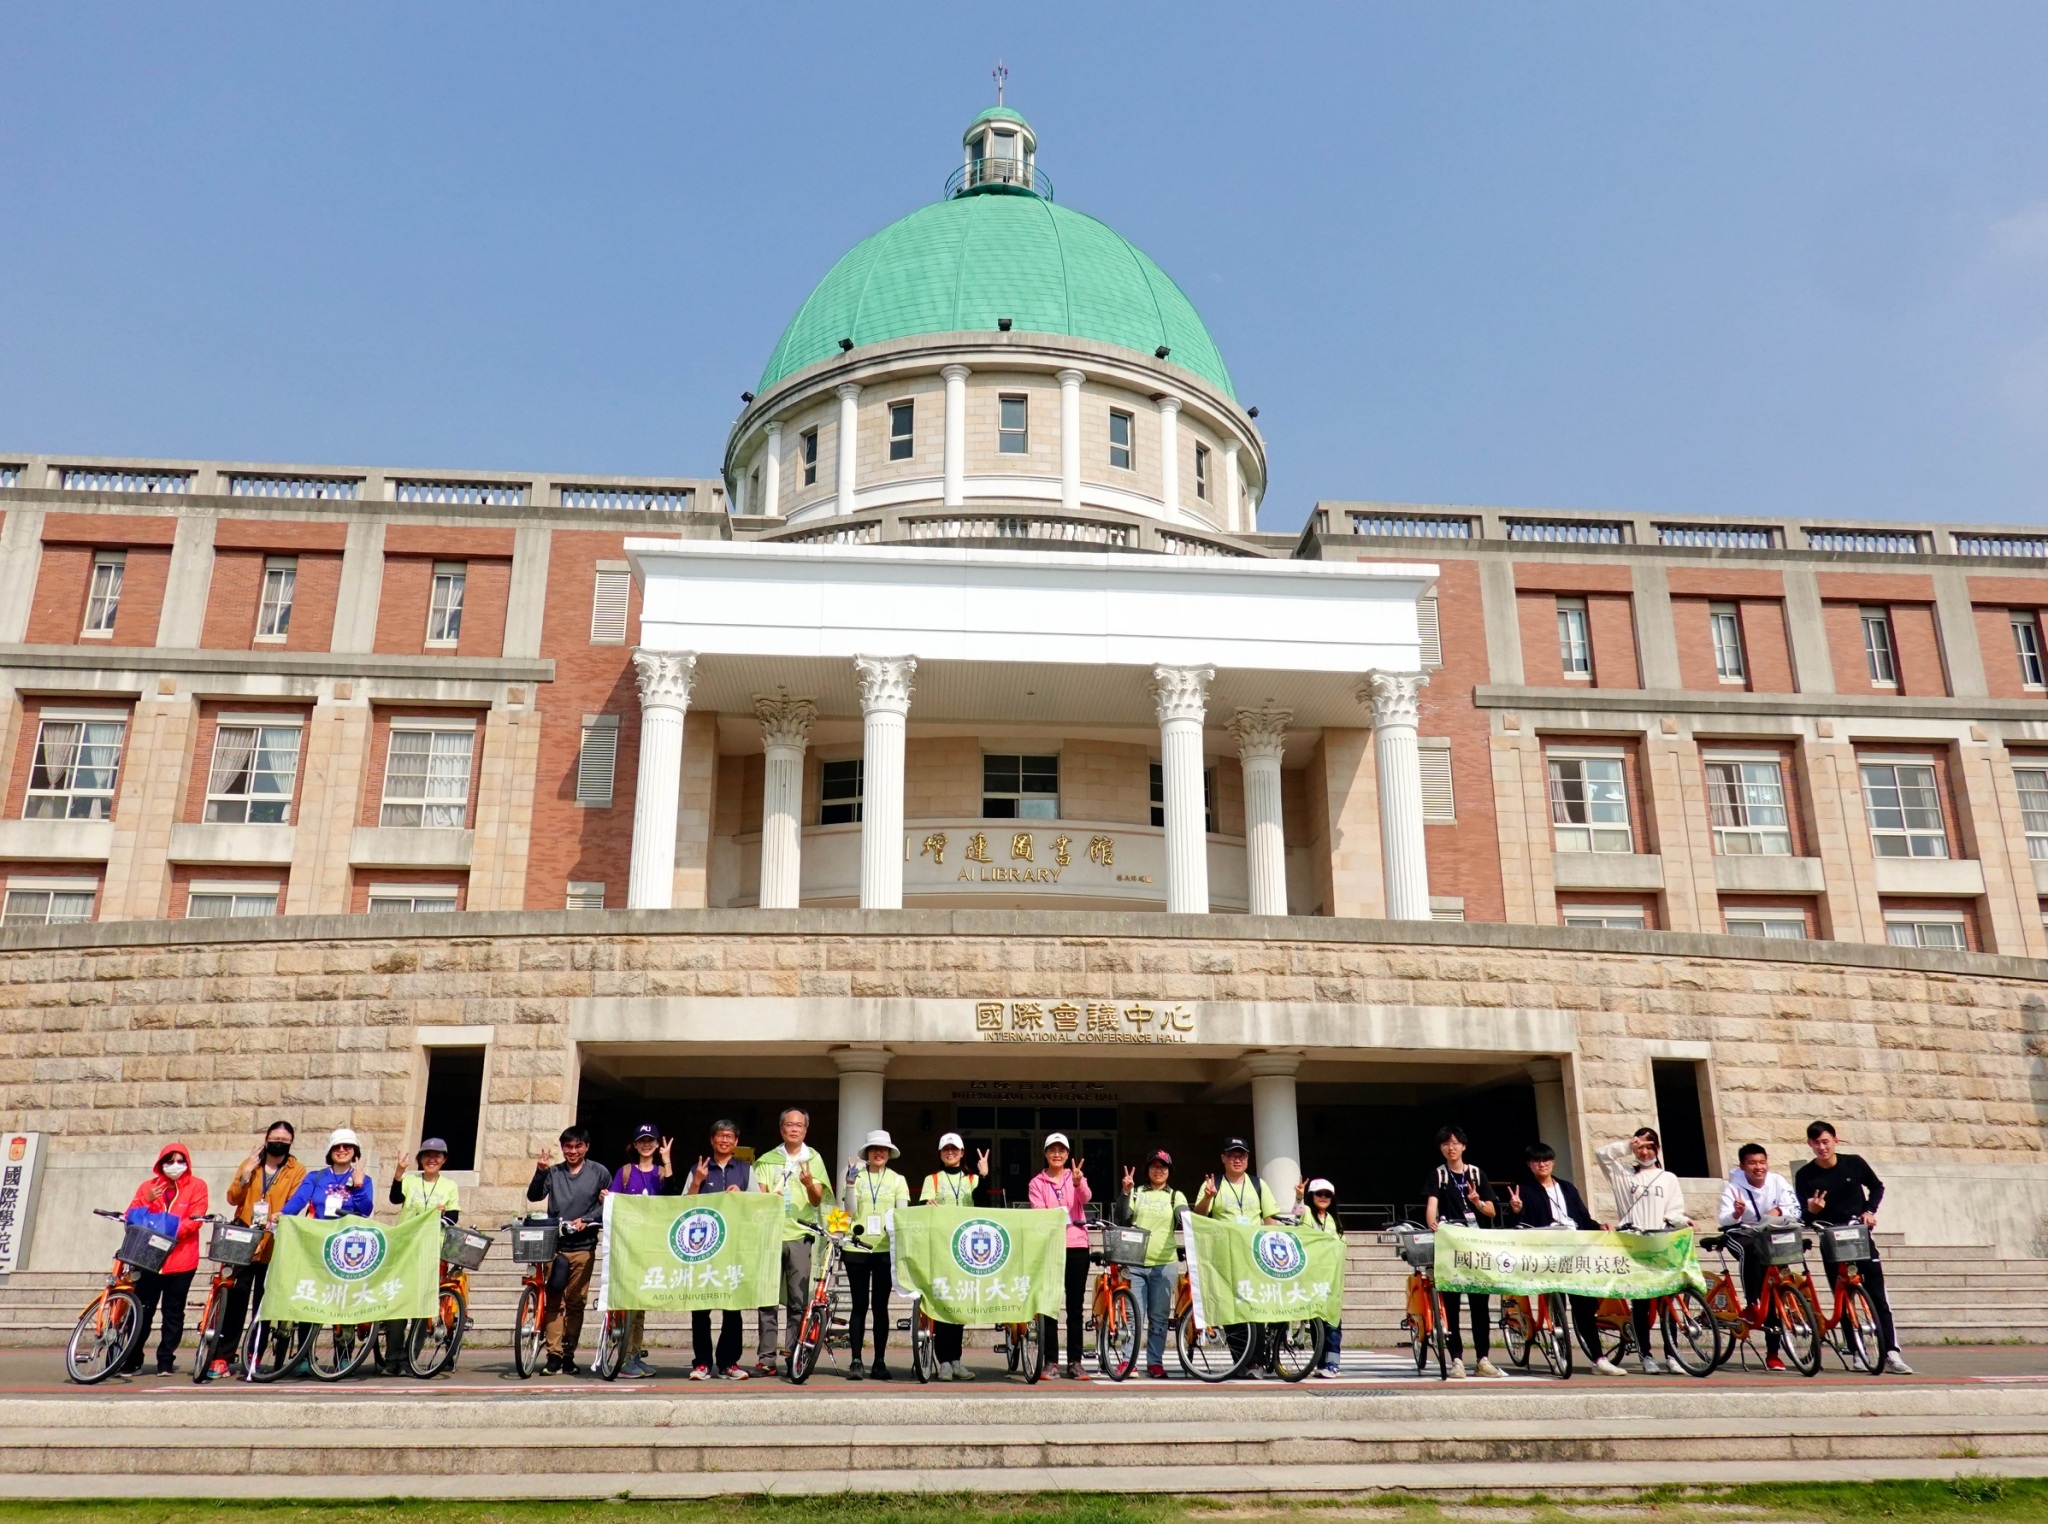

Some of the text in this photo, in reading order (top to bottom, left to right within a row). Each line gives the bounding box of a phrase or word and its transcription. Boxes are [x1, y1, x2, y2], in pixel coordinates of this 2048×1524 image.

[981, 867, 1062, 883] LIBRARY
[975, 1001, 1194, 1032] 國際會議中心
[984, 1032, 1187, 1043] INTERNATIONAL CONFERENCE HALL
[640, 1264, 745, 1291] 亞洲大學
[291, 1277, 404, 1311] 亞洲大學
[652, 1292, 734, 1301] ASIA UNIVERSITY
[932, 1275, 1031, 1304] 亞洲大學
[1235, 1279, 1332, 1307] 亞洲大學
[303, 1303, 390, 1319] ASIA UNIVERSITY
[967, 1304, 1023, 1315] UNIVERSITY
